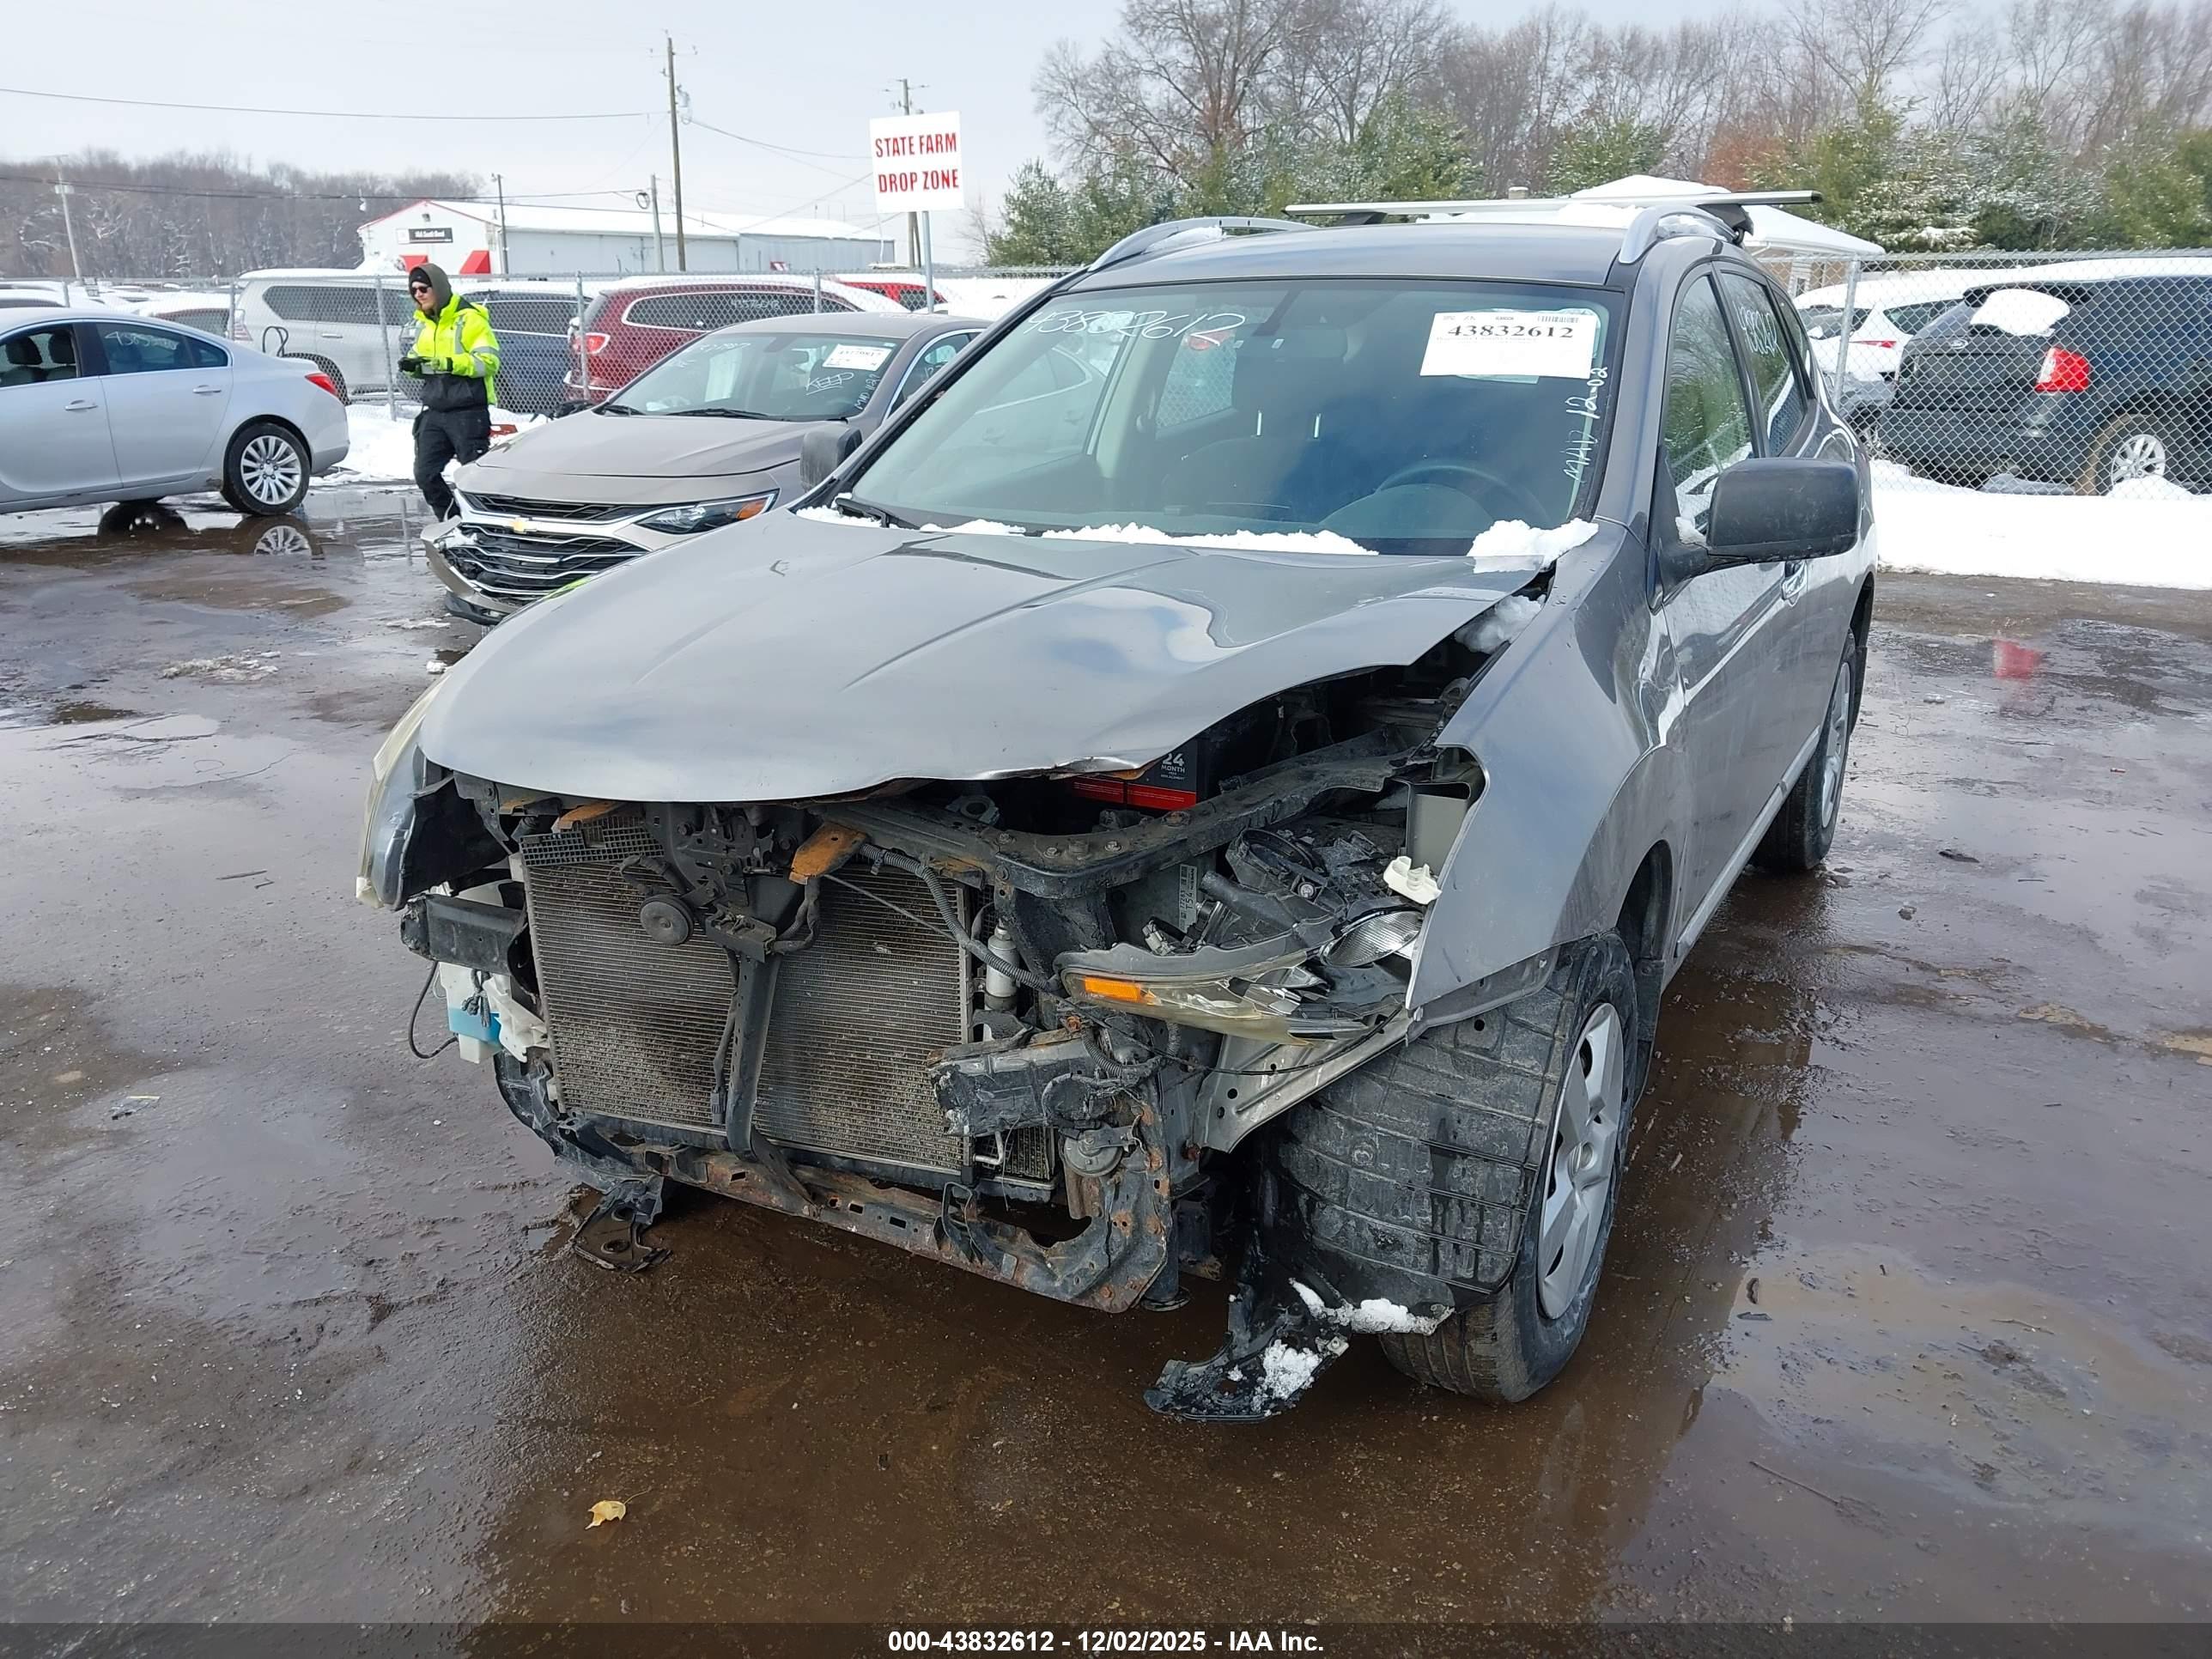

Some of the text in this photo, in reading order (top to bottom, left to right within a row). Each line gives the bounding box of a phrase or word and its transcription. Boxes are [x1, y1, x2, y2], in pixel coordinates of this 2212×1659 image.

[875, 132, 957, 158] STATE FARM
[878, 168, 959, 193] DROP ZONE
[1448, 325, 1573, 338] 43832612
[805, 372, 854, 392] KEEP
[1161, 764, 1186, 773] MONTH
[1162, 753, 1185, 767] 24
